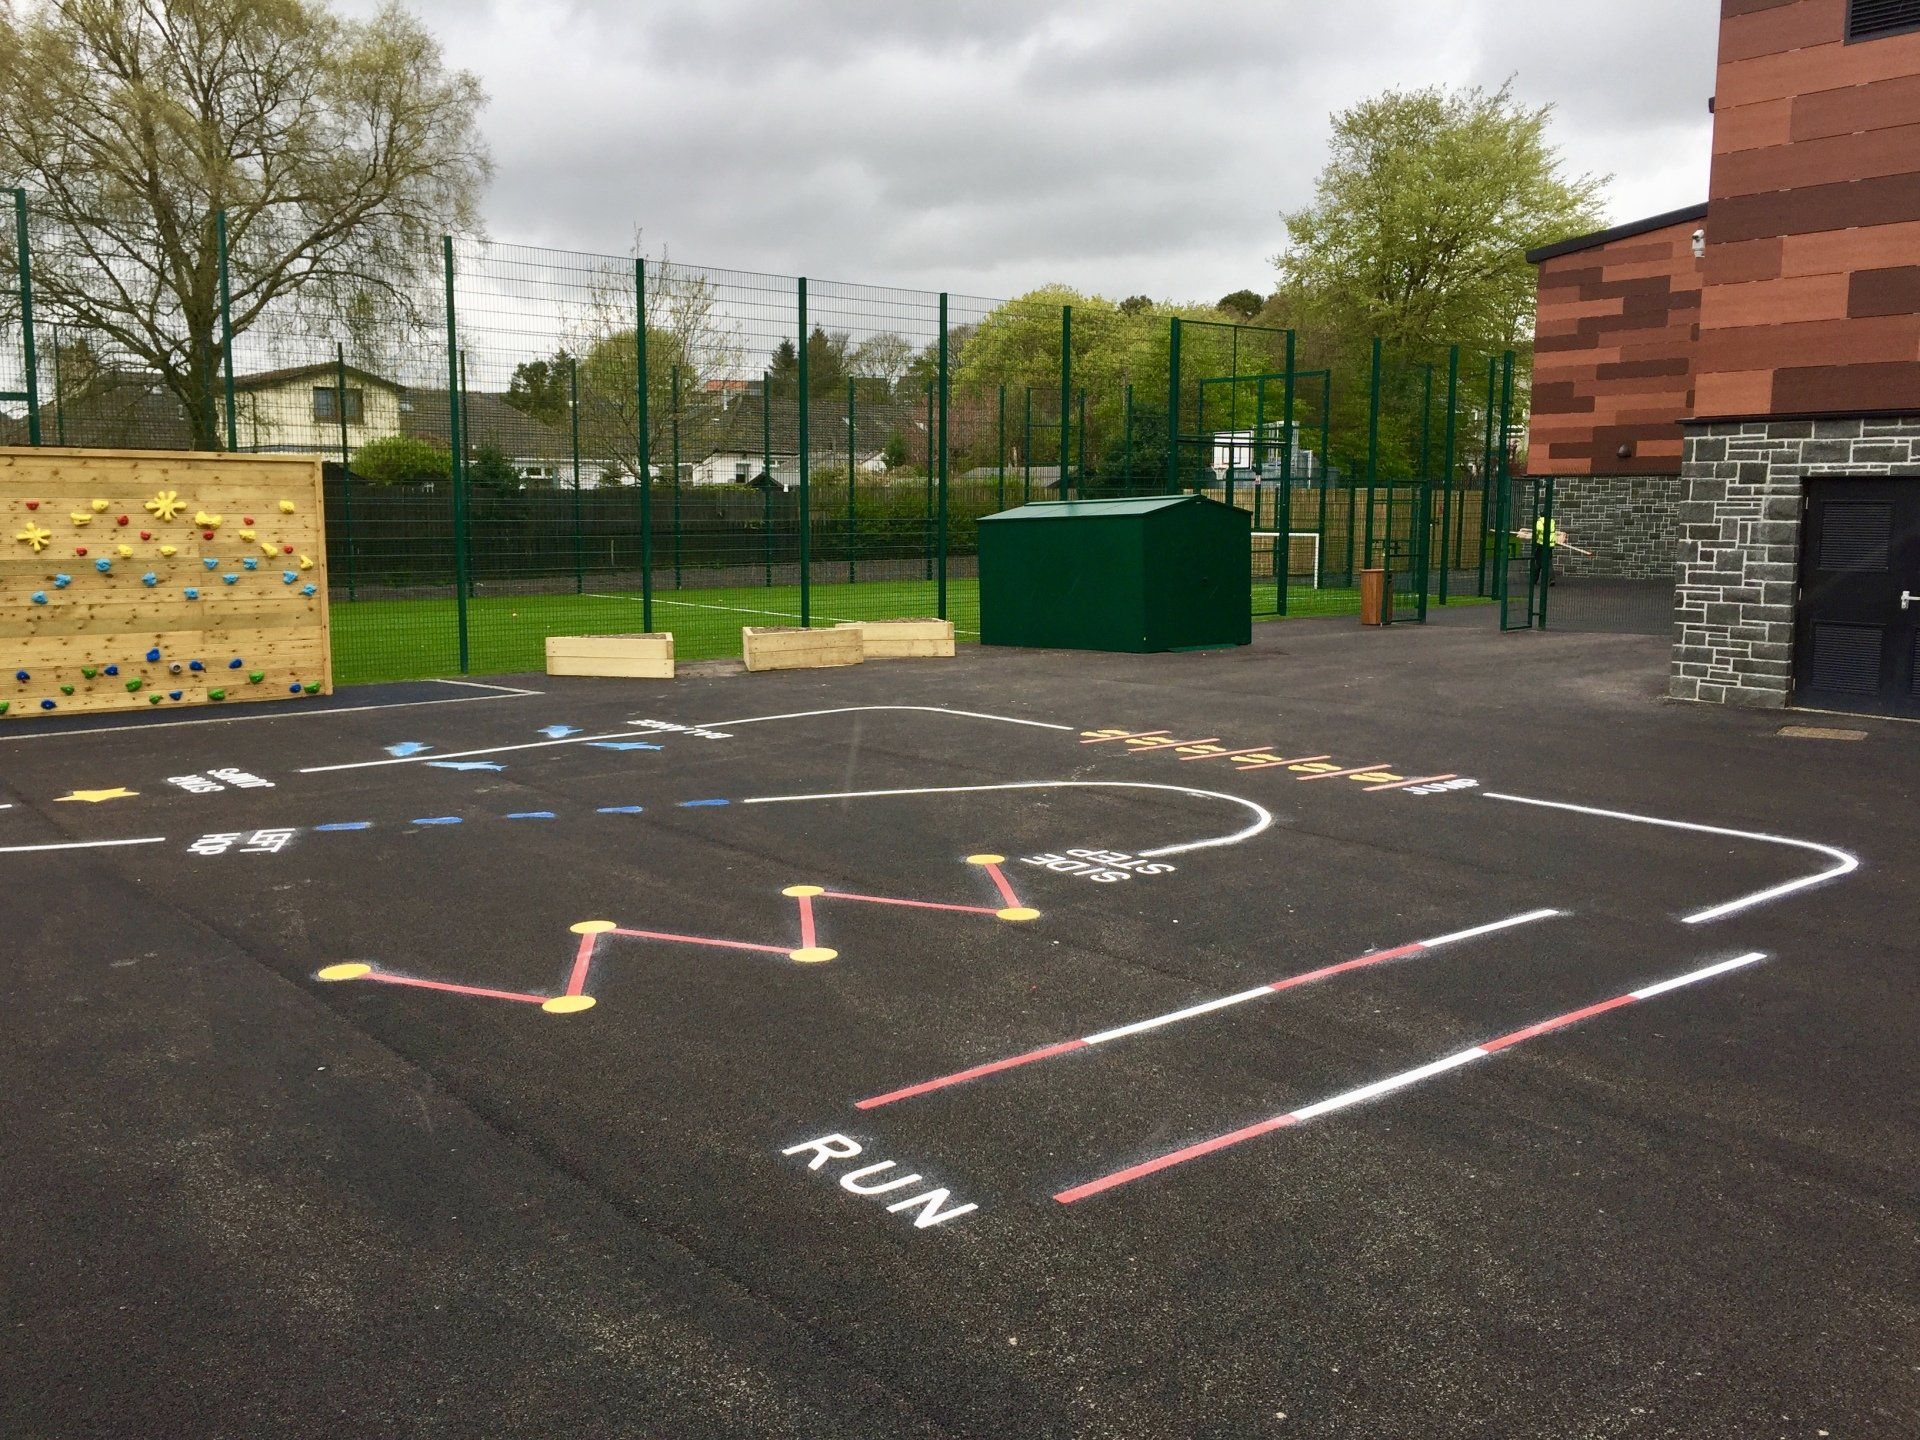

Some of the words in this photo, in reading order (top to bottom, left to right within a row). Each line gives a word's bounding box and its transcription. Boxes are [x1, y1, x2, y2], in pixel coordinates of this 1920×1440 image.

[1402, 779, 1479, 795] JUMP
[186, 833, 242, 855] HOP
[239, 828, 296, 853] LEFT
[1020, 853, 1131, 883] SIDE
[1066, 849, 1176, 875] STEP
[781, 1133, 979, 1229] RUN
